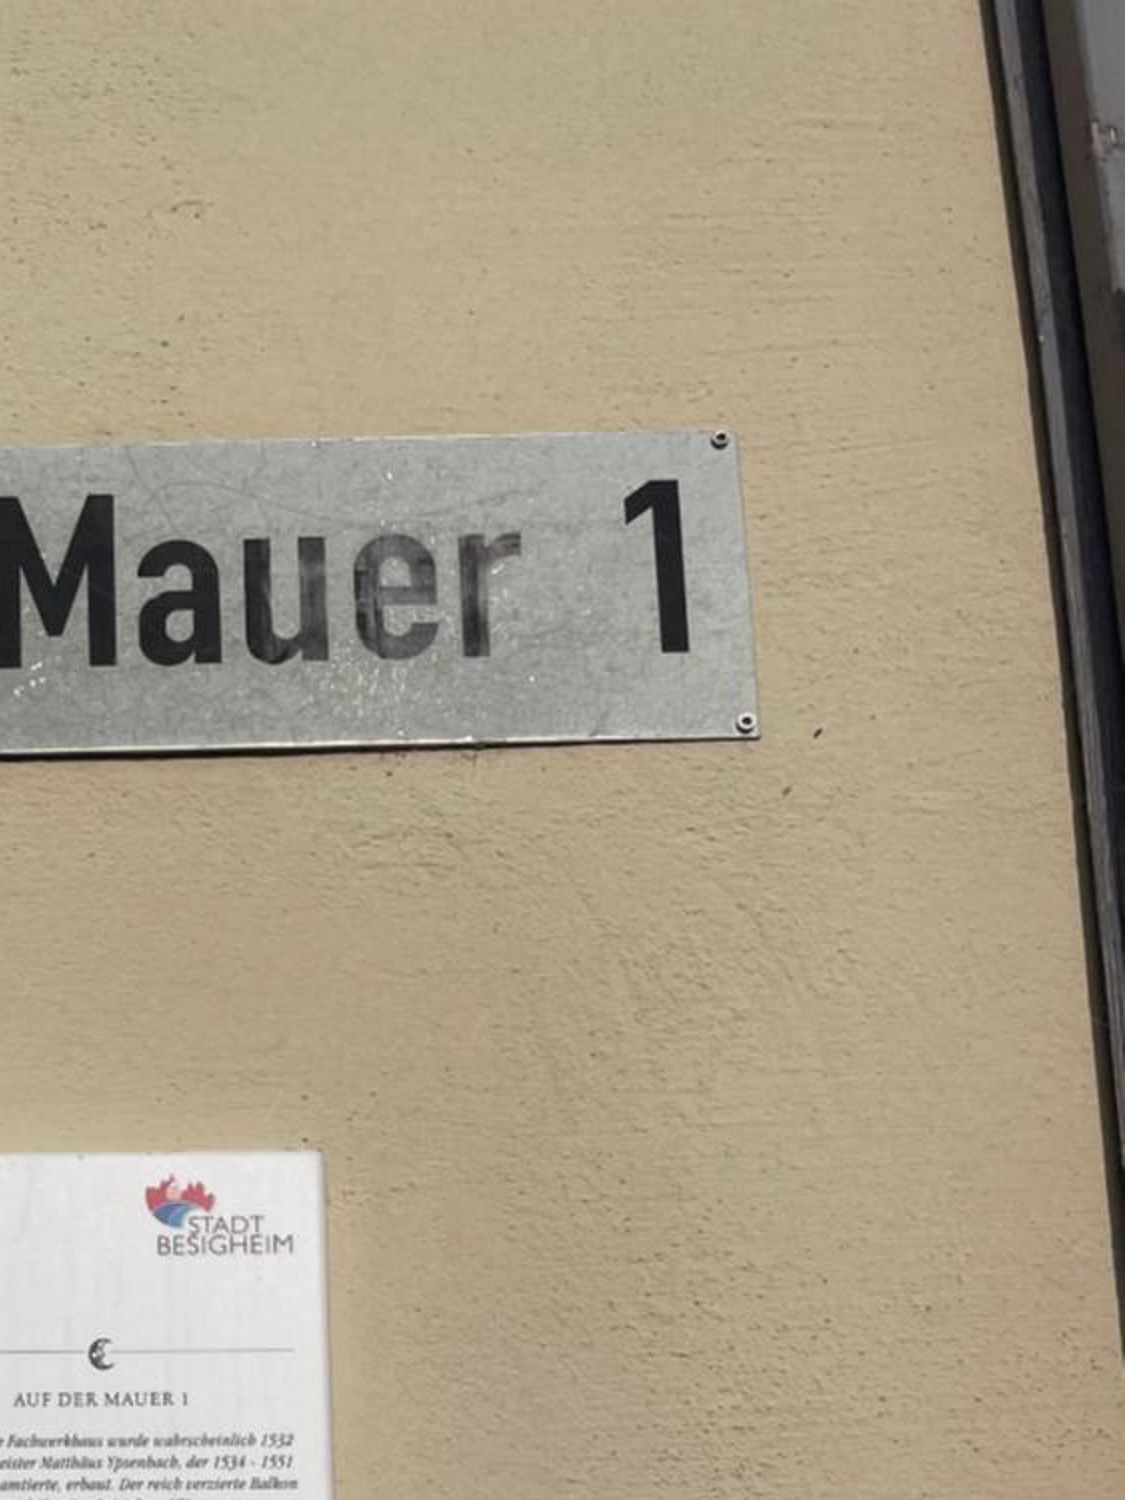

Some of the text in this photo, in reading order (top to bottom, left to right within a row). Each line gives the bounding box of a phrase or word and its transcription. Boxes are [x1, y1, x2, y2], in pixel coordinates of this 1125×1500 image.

[624, 480, 690, 654] 1
[187, 1213, 265, 1234] STADT
[156, 1234, 294, 1257] BESIGHEIM
[13, 1391, 188, 1408] AUF DER MAUER 1
[6, 1433, 104, 1449] Fachwerkhaus
[106, 1433, 151, 1448] wurde
[153, 1432, 257, 1448] wahrscheinlich
[260, 1432, 295, 1450] 1532
[38, 1454, 103, 1470] Matthäus
[185, 1454, 209, 1469] der
[214, 1454, 246, 1472] 1534
[261, 1454, 293, 1470] 1551
[118, 1477, 144, 1492] Der
[146, 1476, 183, 1492] reich
[185, 1476, 247, 1491] verzierte
[248, 1475, 299, 1490] Balkon
